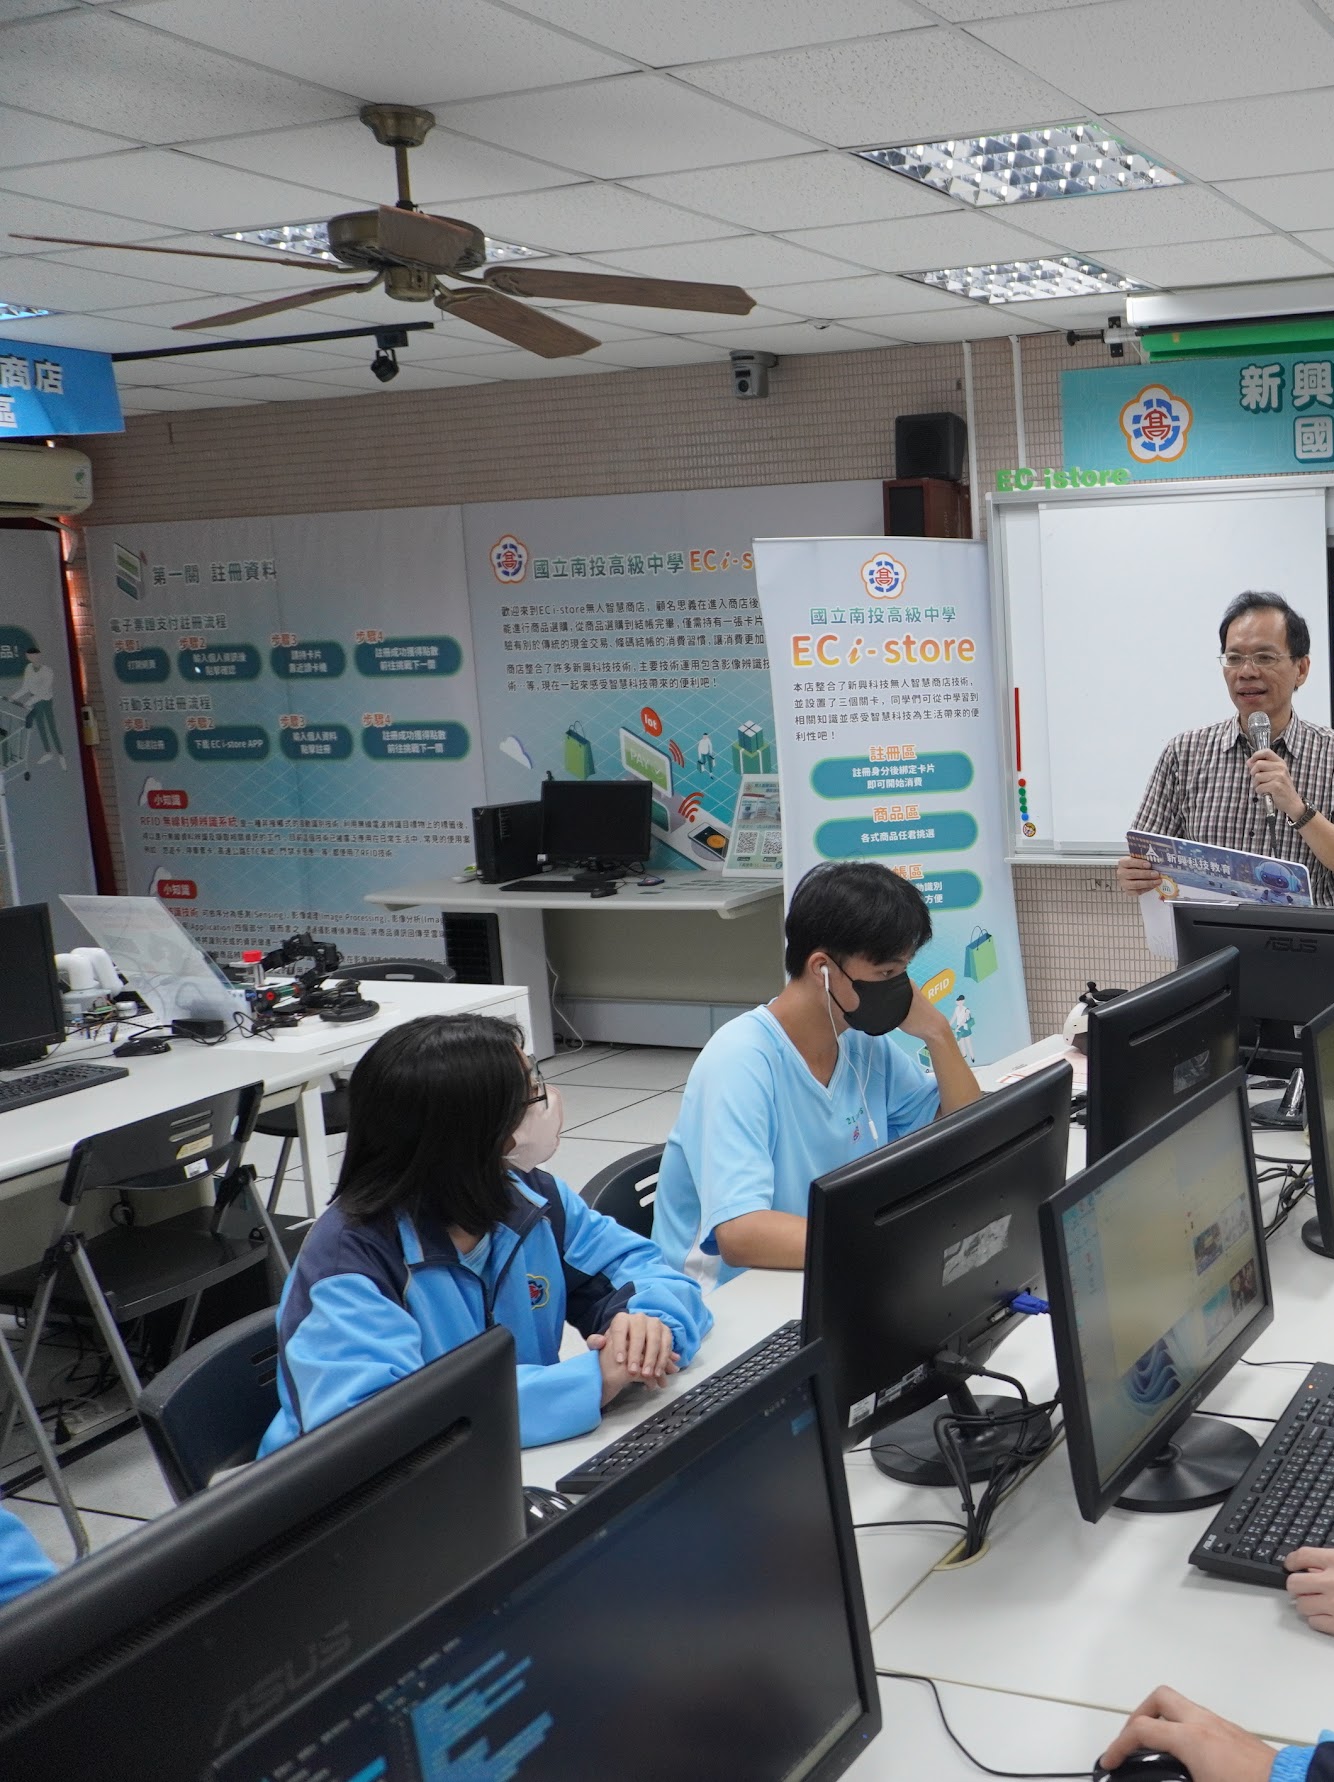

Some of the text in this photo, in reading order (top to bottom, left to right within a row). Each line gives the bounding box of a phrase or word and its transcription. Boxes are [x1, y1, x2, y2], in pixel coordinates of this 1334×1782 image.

[996, 466, 1132, 492] EC istore
[153, 560, 278, 586] 第一關 註冊資料
[533, 552, 684, 579] 國立南投高級中學
[689, 550, 717, 572] EC
[810, 606, 957, 625] 國立南投高級中學
[792, 634, 839, 666] EC
[869, 744, 917, 761] 註冊區
[852, 764, 935, 778] 註冊身分後綁定卡片
[866, 777, 923, 790] 即可開始消費
[872, 804, 921, 823] 商品區
[861, 828, 935, 843] 各式商品任君挑選
[1166, 852, 1231, 875] 新興科技教育
[925, 893, 944, 904] 方便
[927, 977, 951, 999] RFID
